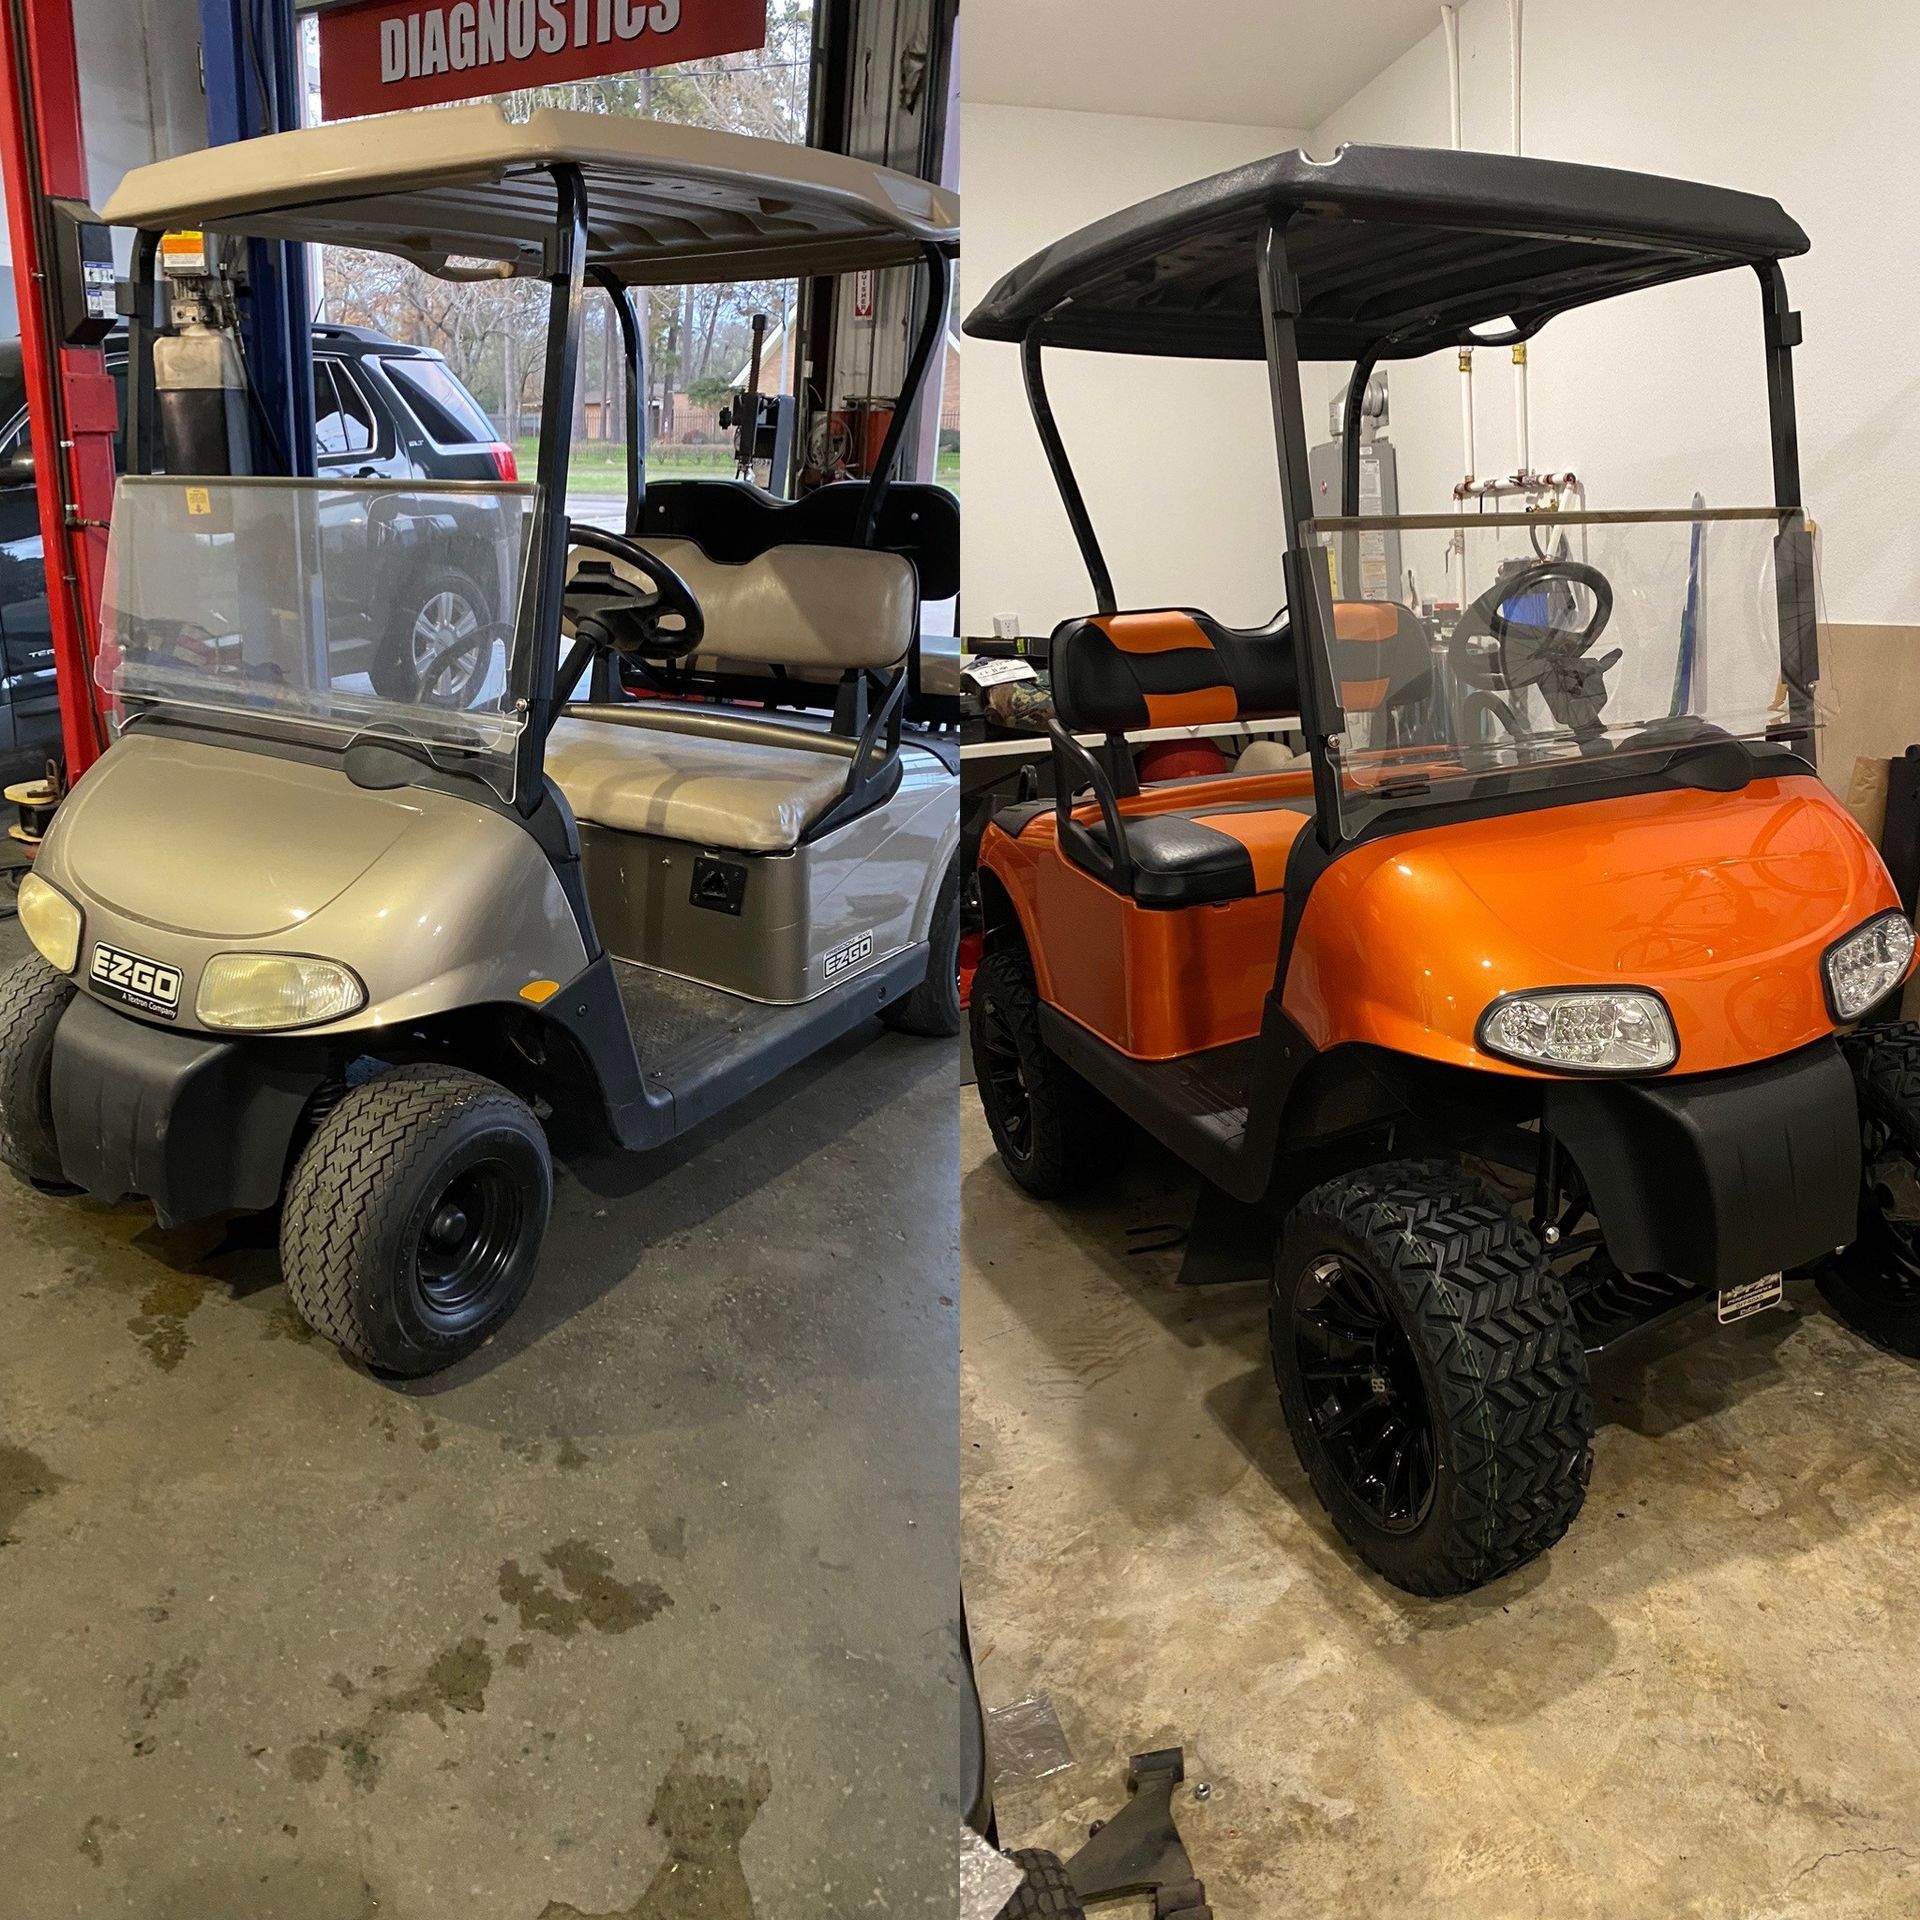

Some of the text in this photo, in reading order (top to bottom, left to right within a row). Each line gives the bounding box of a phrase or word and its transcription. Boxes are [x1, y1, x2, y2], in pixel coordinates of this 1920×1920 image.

[380, 0, 681, 83] DIAGNOSTICS
[121, 992, 177, 1019] A Textron Company
